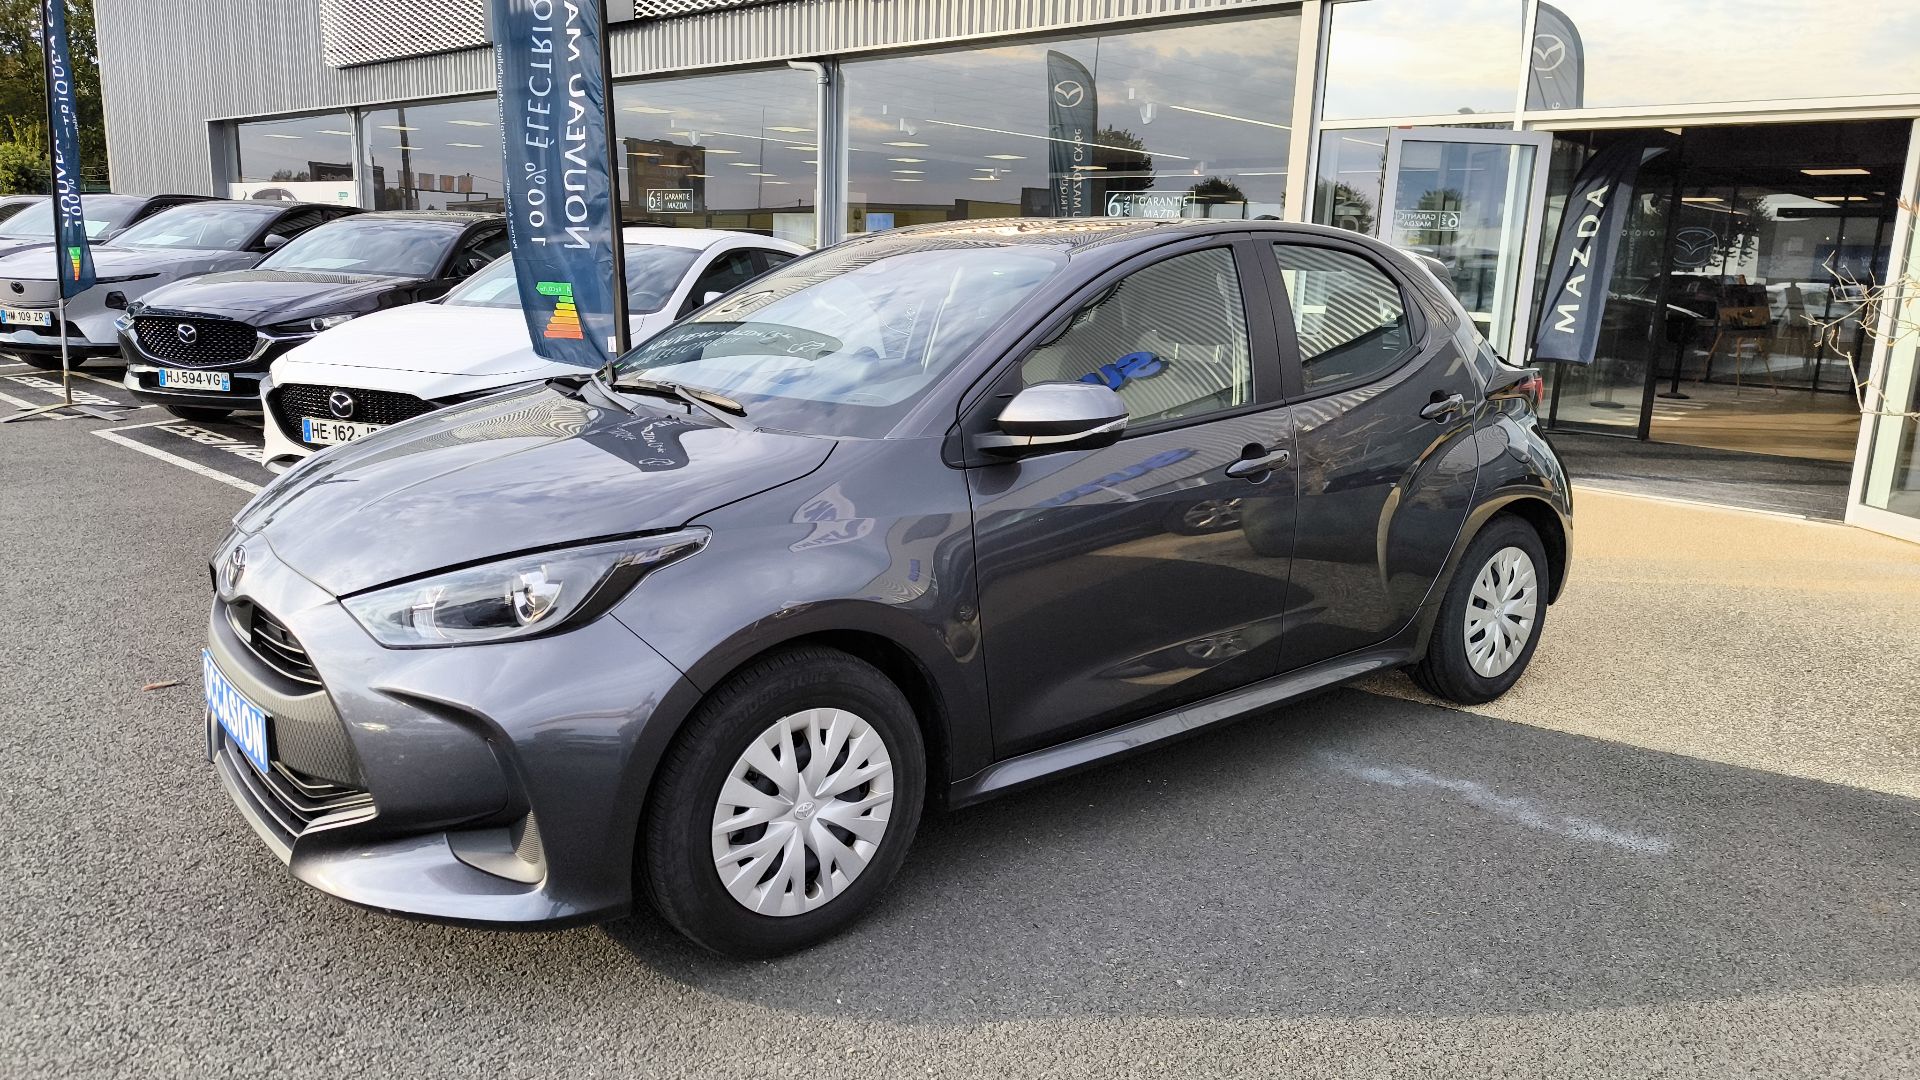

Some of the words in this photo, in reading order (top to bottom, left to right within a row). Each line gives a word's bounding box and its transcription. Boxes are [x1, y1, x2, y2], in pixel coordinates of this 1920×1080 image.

[1107, 193, 1121, 217] 6
[1138, 196, 1189, 207] GARANTIE
[1143, 209, 1181, 218] MAZDA
[1554, 184, 1610, 334] MAZDA
[204, 656, 266, 763] OCCASION
